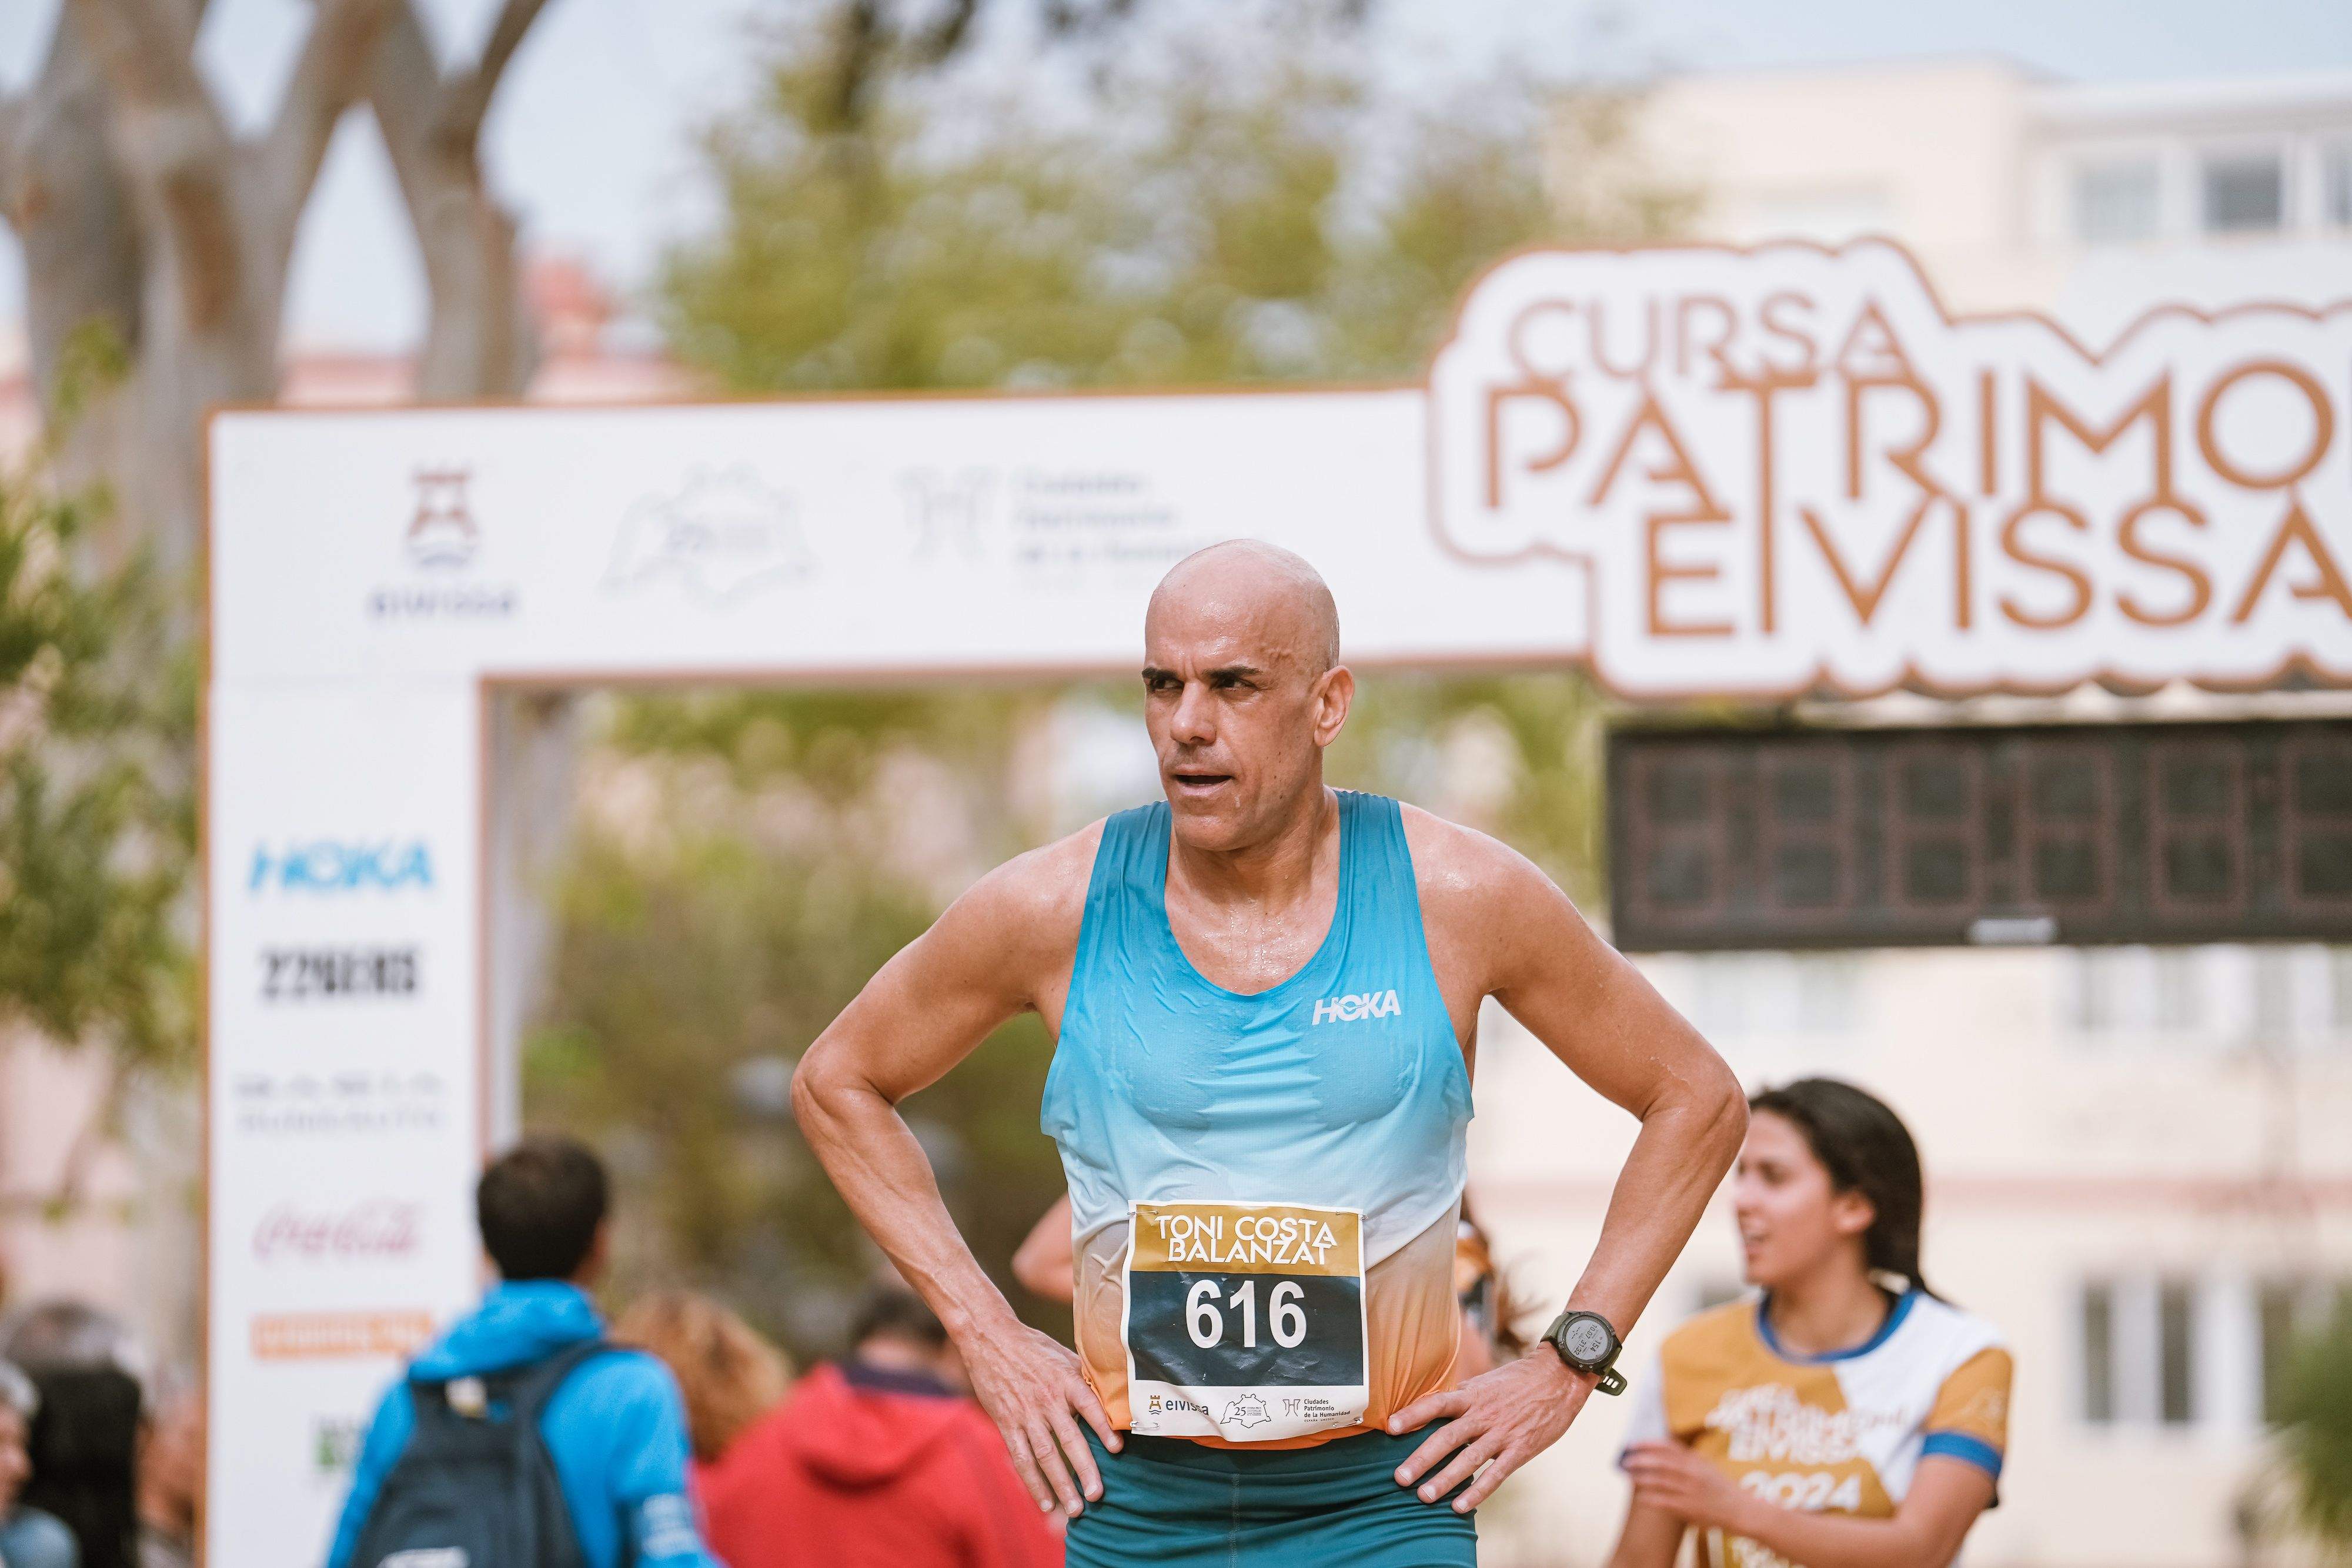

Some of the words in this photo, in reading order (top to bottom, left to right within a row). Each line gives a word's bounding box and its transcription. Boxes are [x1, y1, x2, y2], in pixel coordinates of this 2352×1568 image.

[1508, 292, 1918, 383] CURSA
[1485, 360, 2352, 510] PATRIMO
[1645, 500, 2352, 636] EIVISSA
[248, 843, 432, 888] HOKA
[1312, 989, 1402, 1025] HOKA
[1154, 1215, 1223, 1240] TONI
[1234, 1216, 1338, 1247] COSTA
[1168, 1238, 1332, 1265] BALANZAT
[1185, 1279, 1307, 1349] 616
[1590, 1340, 1601, 1352] 154
[1234, 1406, 1246, 1417] 25
[1739, 1470, 1860, 1511] 2024
